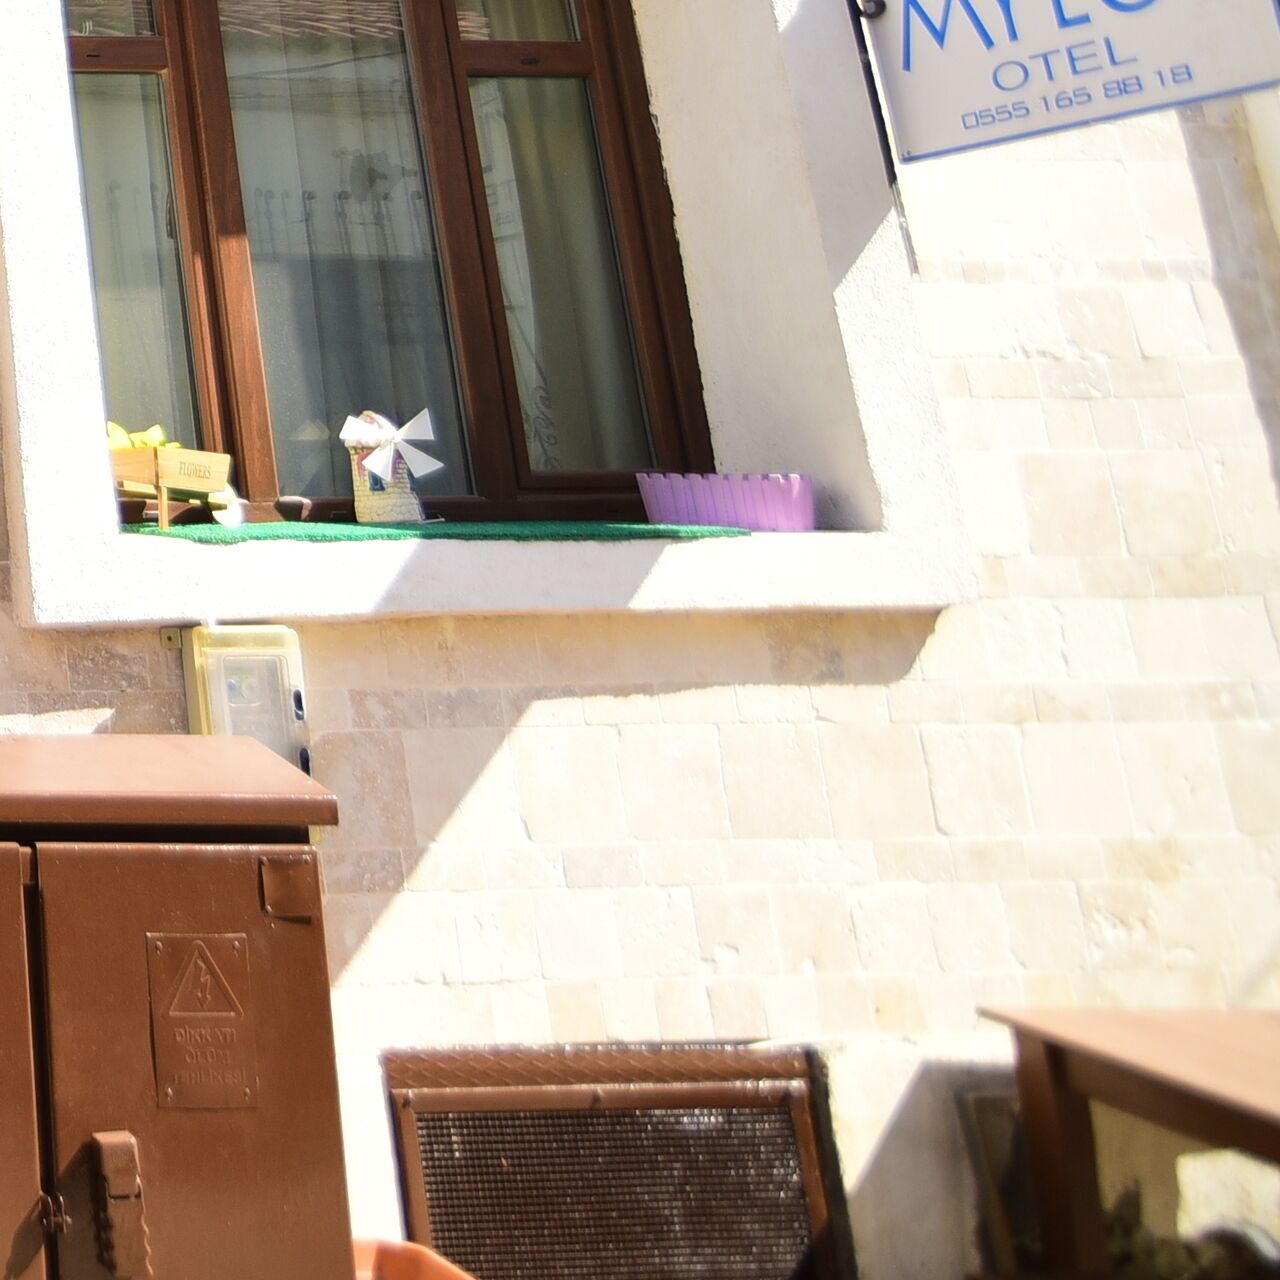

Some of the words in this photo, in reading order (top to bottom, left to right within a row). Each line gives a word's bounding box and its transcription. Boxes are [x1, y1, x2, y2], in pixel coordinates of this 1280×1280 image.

[992, 36, 1138, 92] OTEL
[961, 100, 1031, 130] 0555
[1040, 87, 1093, 113] 165
[1103, 75, 1144, 96] 88
[1156, 63, 1193, 88] 18
[178, 461, 212, 480] FLOWERS
